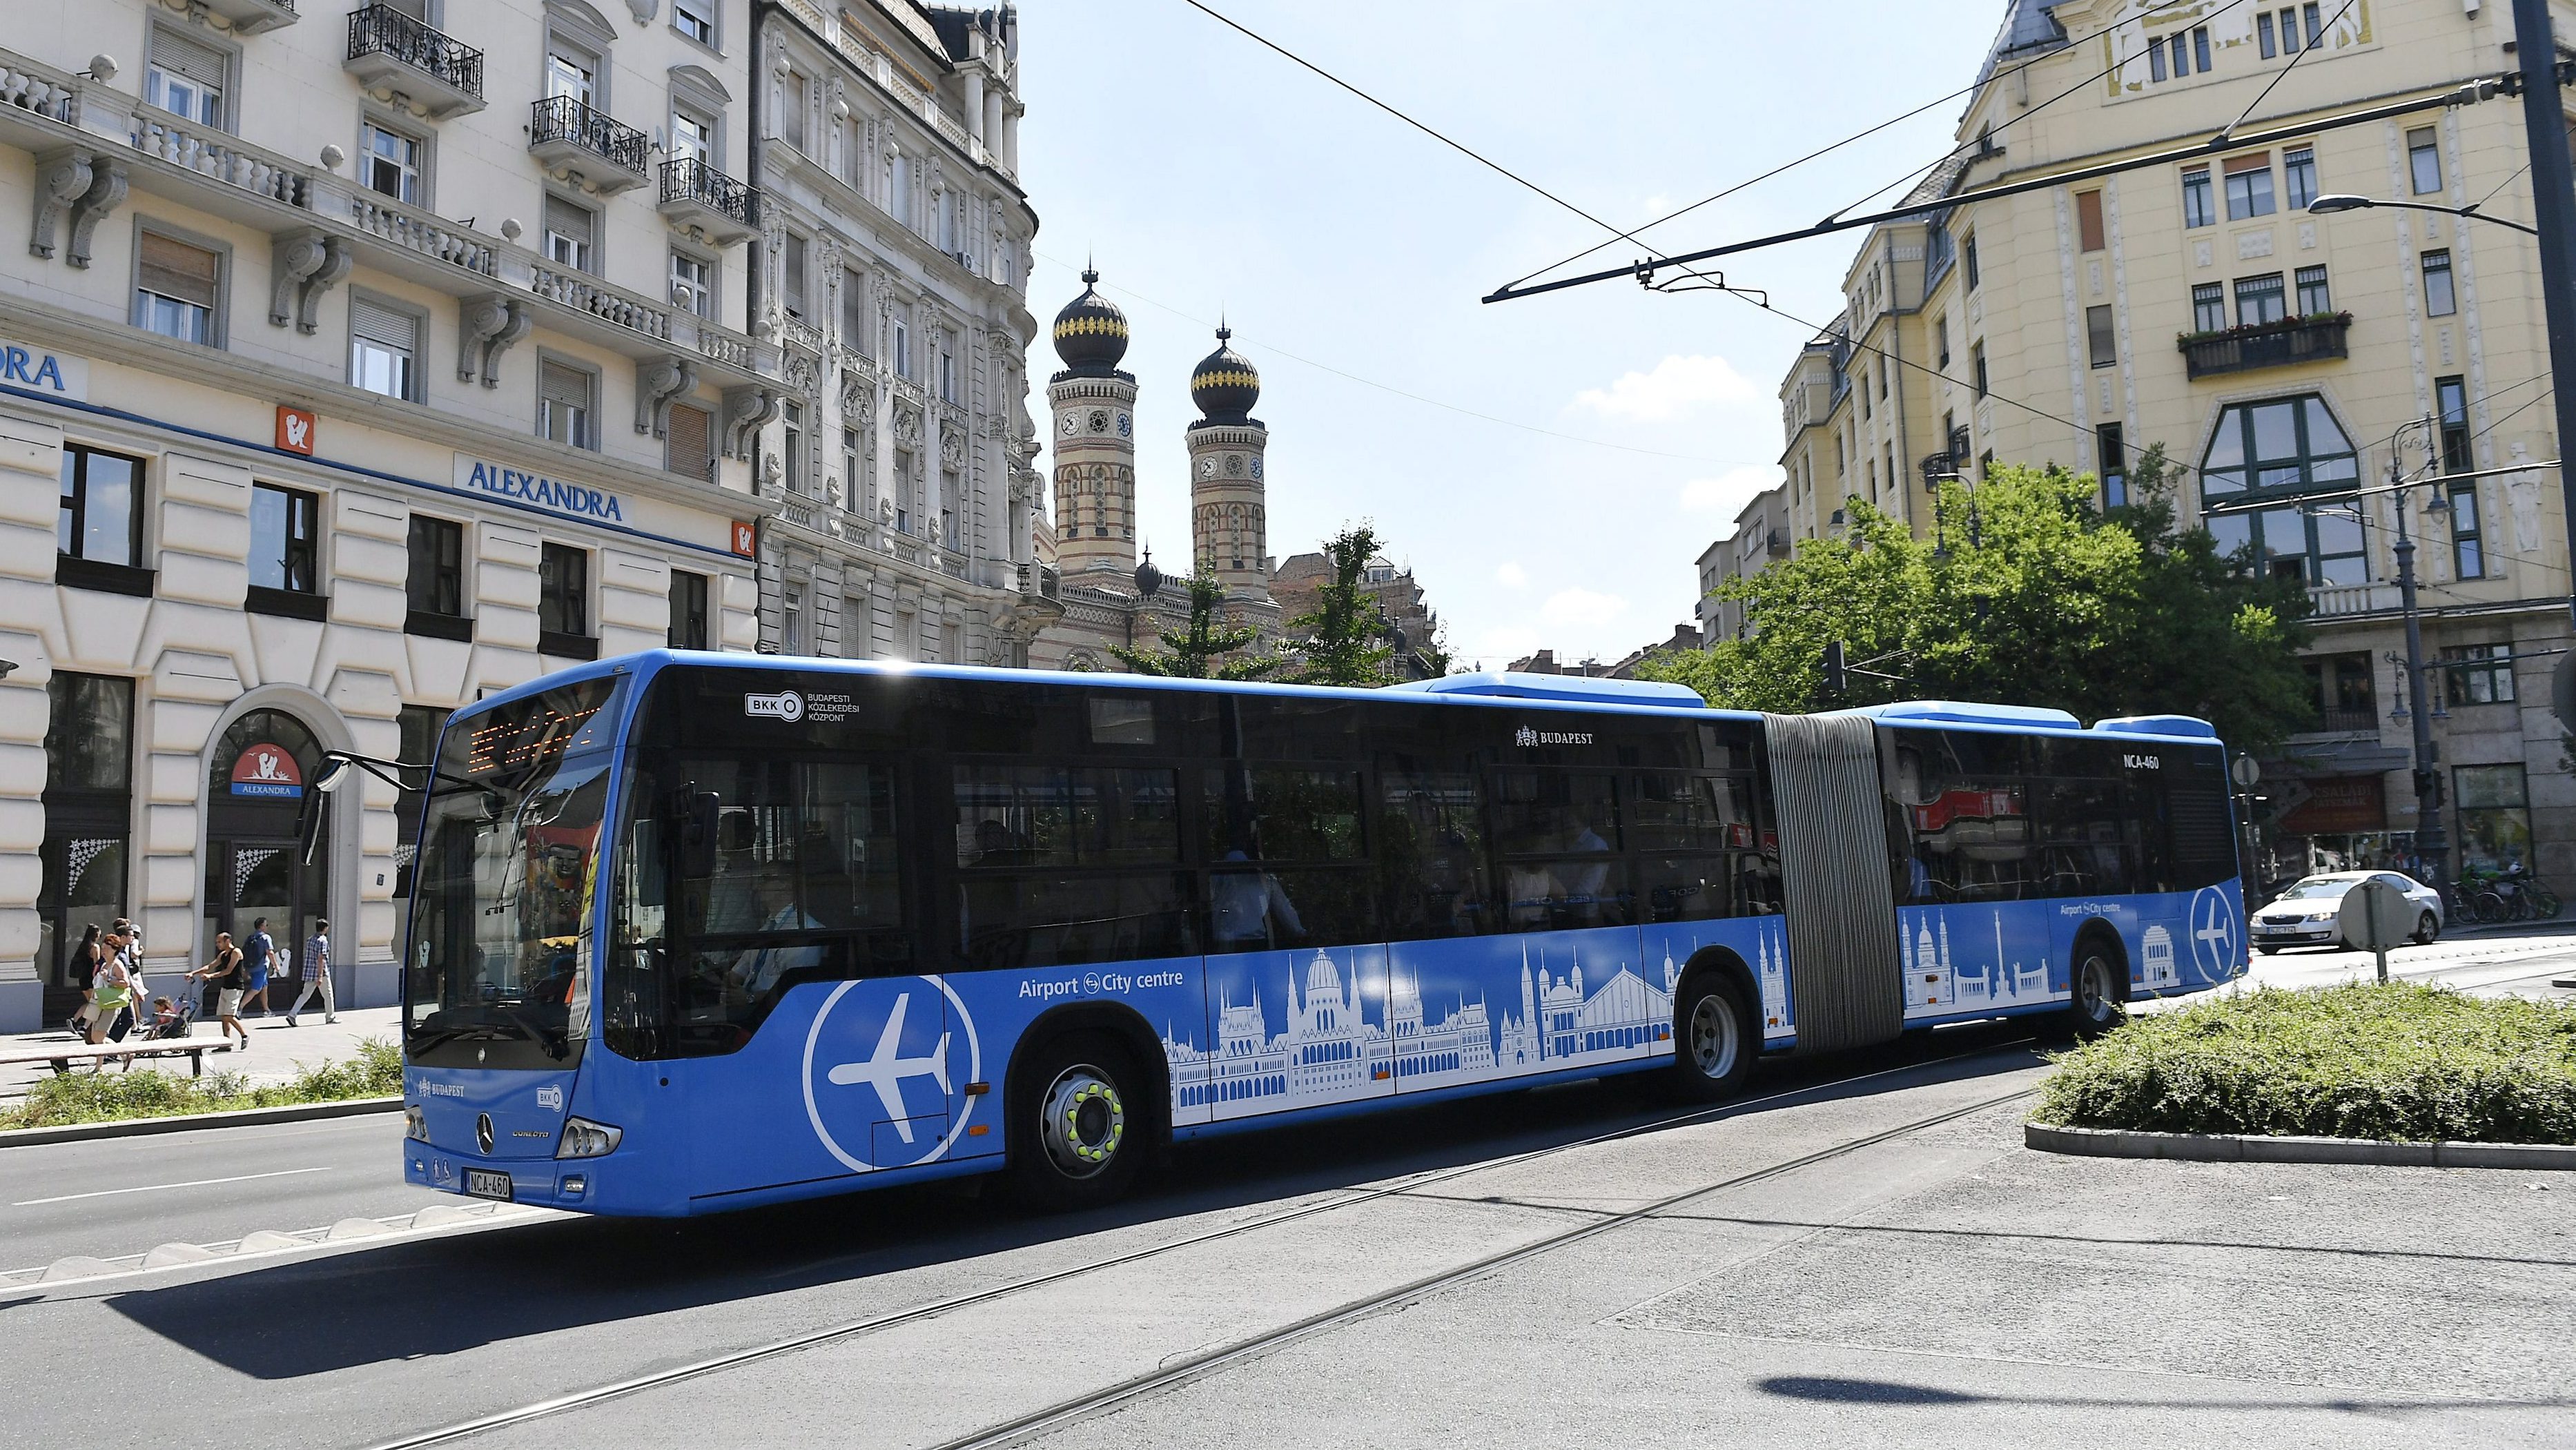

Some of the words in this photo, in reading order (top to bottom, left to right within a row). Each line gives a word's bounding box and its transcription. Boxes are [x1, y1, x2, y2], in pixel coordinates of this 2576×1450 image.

[0, 346, 66, 391] RA
[468, 462, 623, 522] ALEXANDRA
[808, 693, 850, 703] BUDAPESTI
[753, 700, 778, 710] BKK
[808, 703, 859, 713] KÖZLEKEDÉSI
[808, 712, 846, 722] KÖZPONT
[1540, 732, 1593, 745] BUDAPEST
[2123, 754, 2159, 770] NCA-460
[242, 785, 291, 795] ALEXANDRA
[2060, 904, 2082, 917] Airport
[2090, 903, 2102, 916] City
[2102, 903, 2120, 912] centre
[1019, 977, 1079, 1001] Airport
[1102, 974, 1131, 994] City
[1137, 970, 1183, 988] centre
[431, 1083, 465, 1098] BUDAPEST
[540, 1093, 552, 1102] BKK
[471, 1170, 508, 1197] NCA-460
